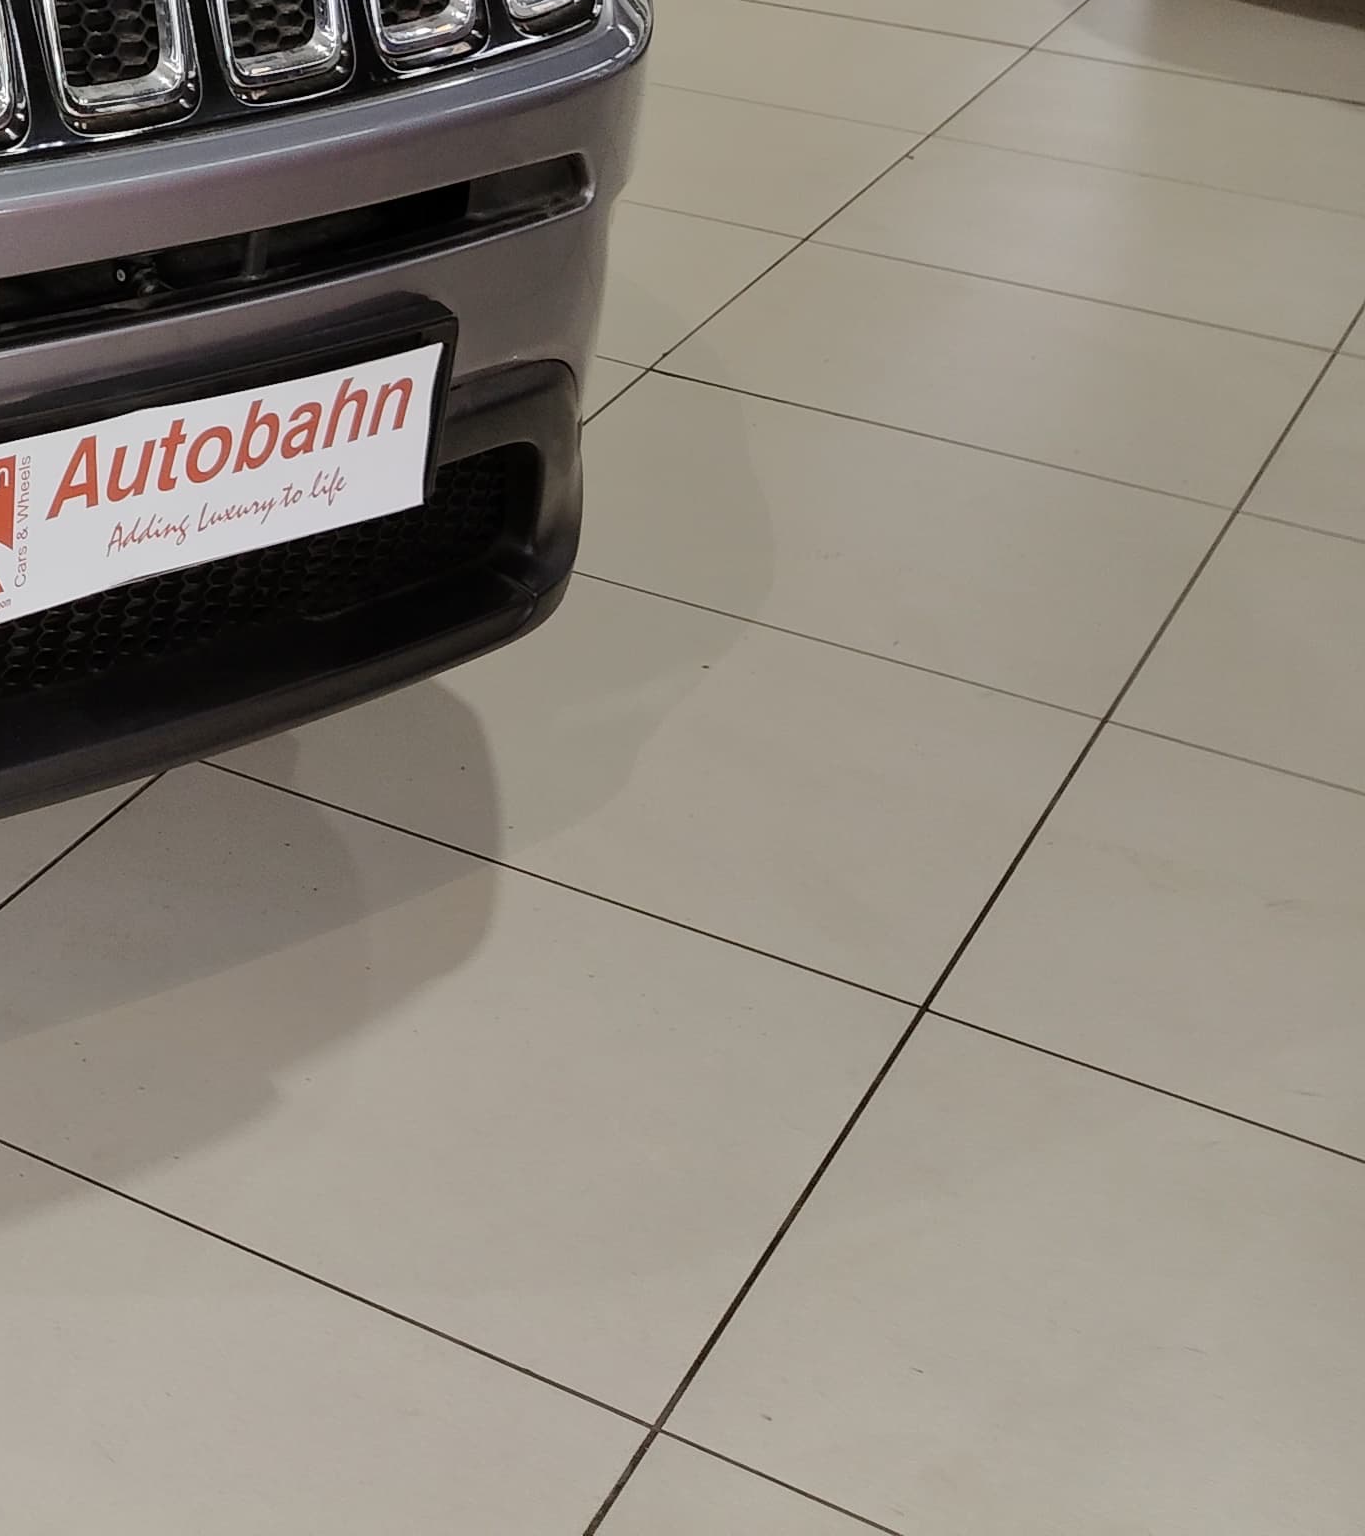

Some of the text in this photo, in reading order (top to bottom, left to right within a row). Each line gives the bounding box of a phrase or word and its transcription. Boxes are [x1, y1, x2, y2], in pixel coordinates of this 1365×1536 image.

[45, 376, 414, 520] Autobahn
[106, 466, 348, 557] Adding Luxury to life
[14, 455, 31, 588] Cars & Wheels
